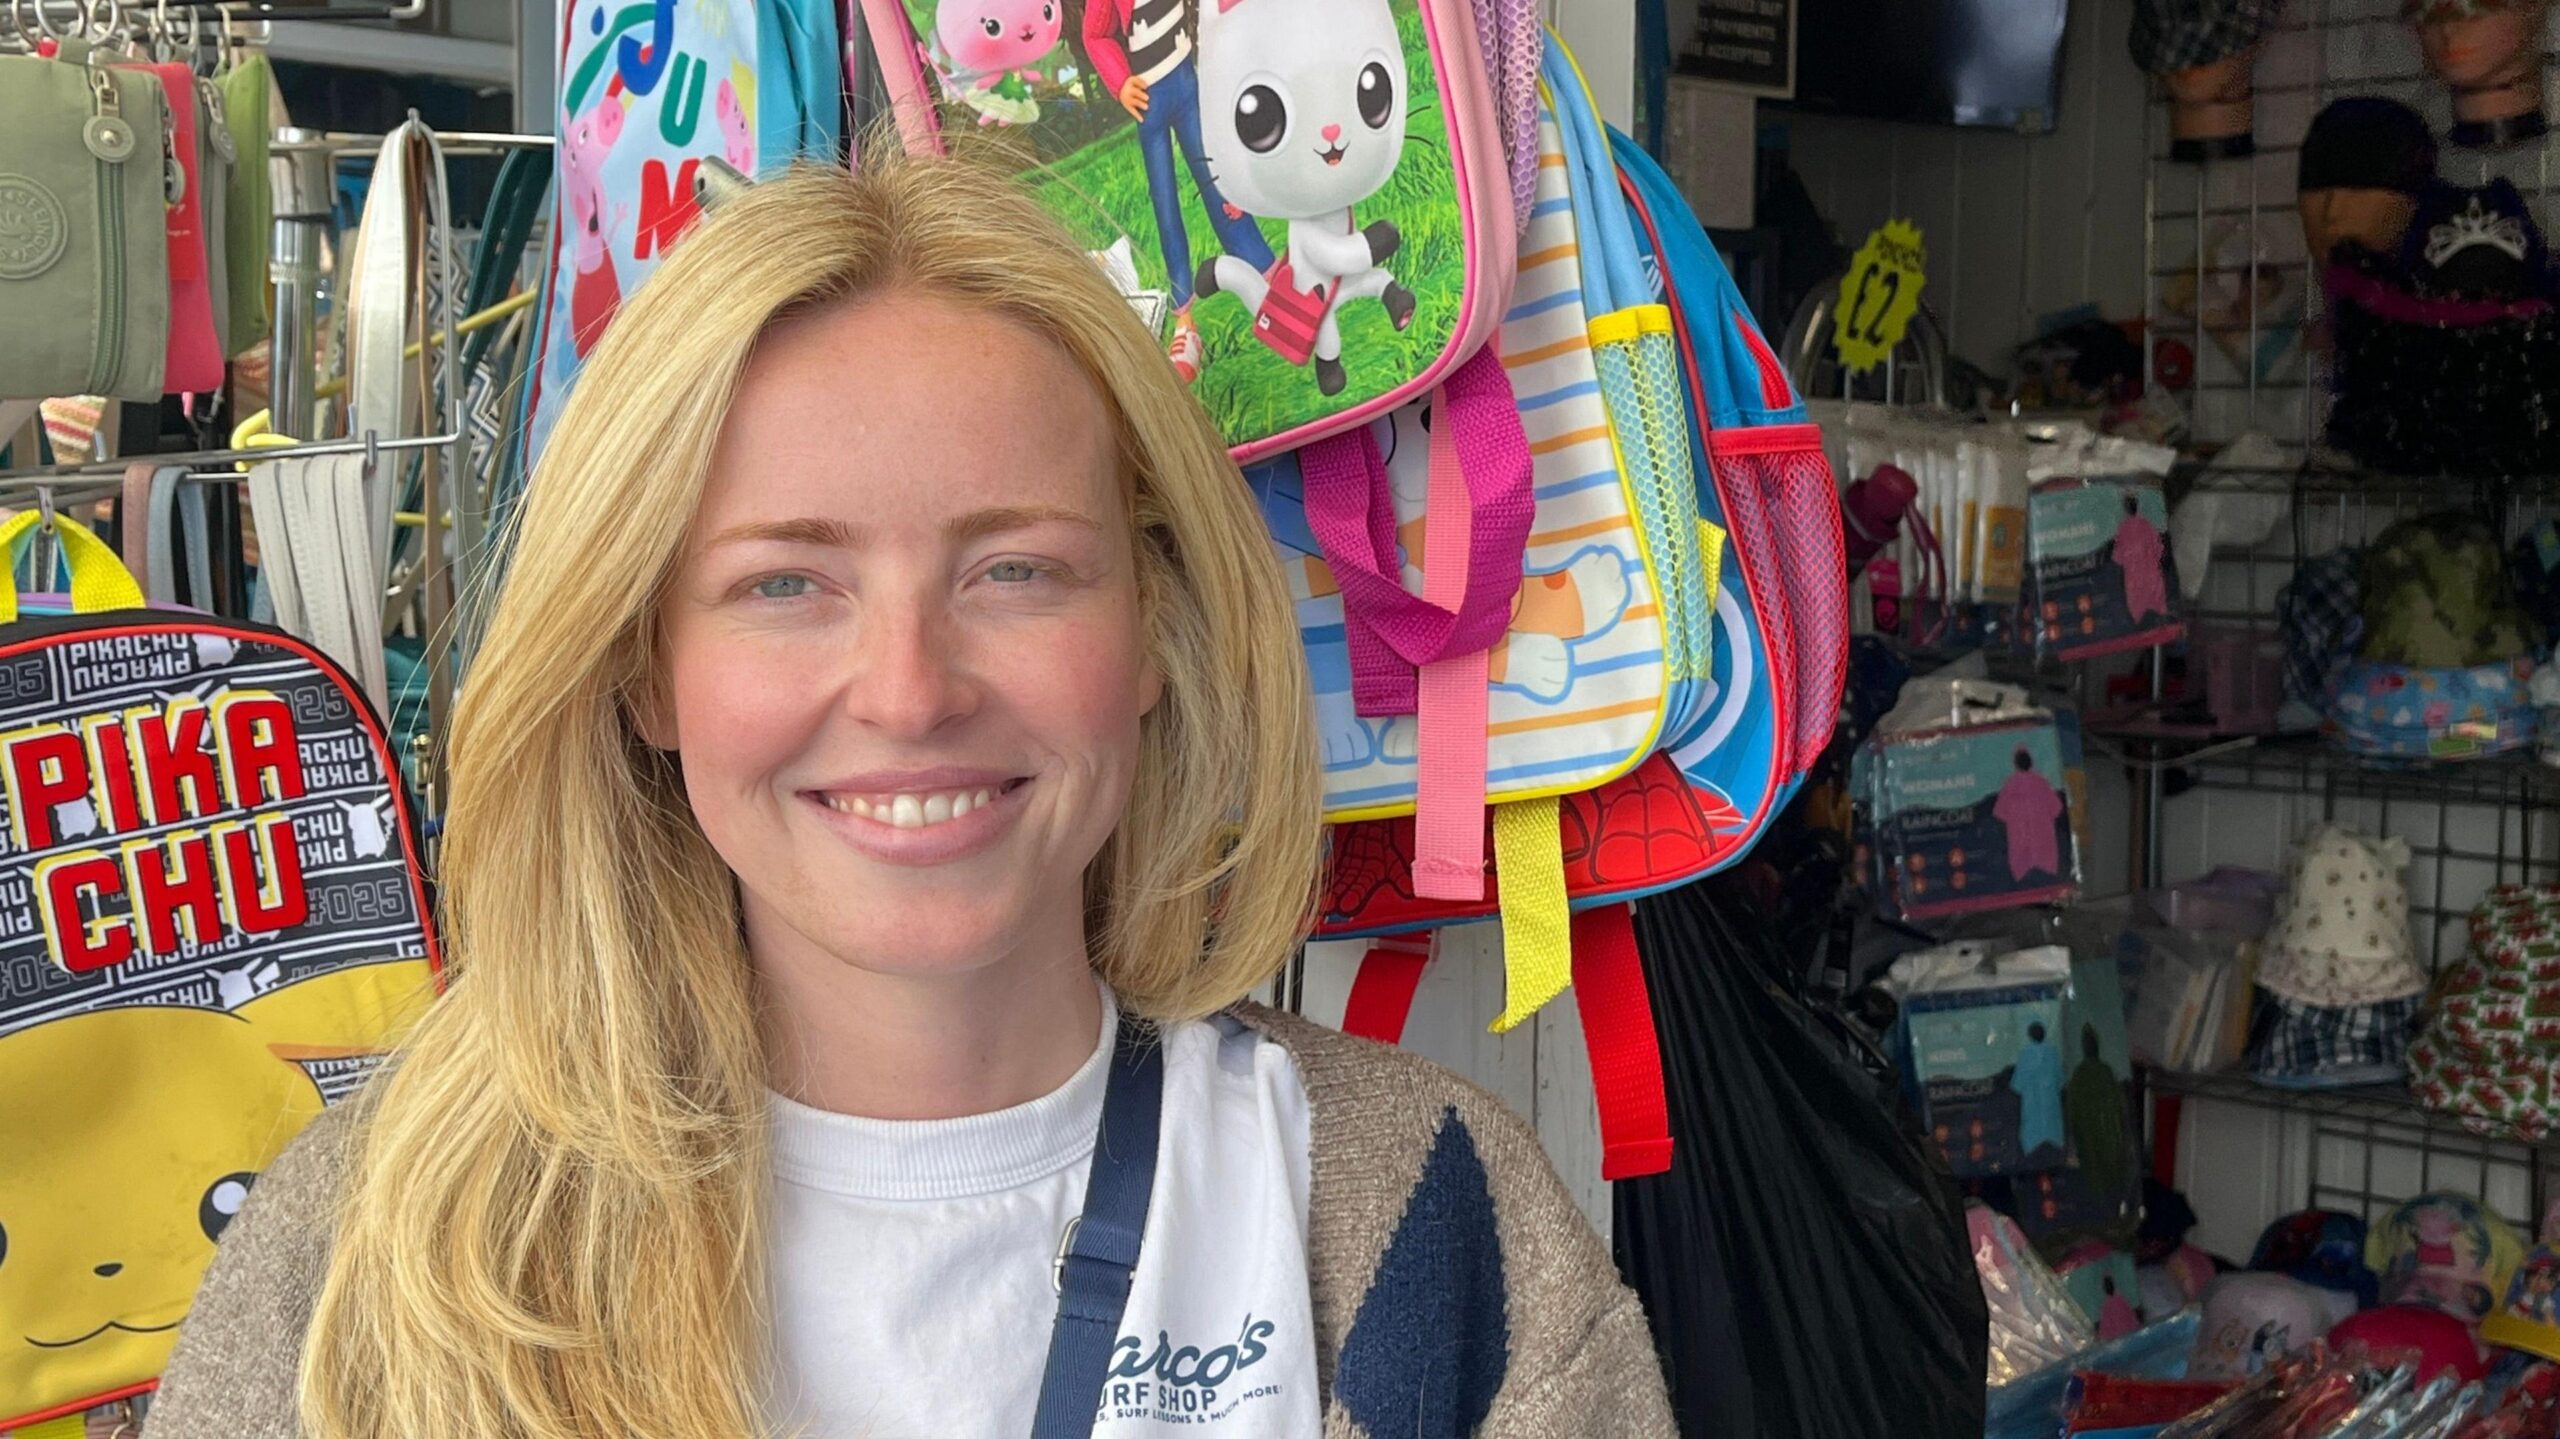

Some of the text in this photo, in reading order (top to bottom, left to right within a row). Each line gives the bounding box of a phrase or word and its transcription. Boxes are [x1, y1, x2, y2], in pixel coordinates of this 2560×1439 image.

[70, 633, 189, 665] PIKACHU
[3, 690, 306, 850] PIKA
[298, 736, 366, 768] ACHU
[34, 812, 308, 974] CHU
[304, 877, 406, 927] #025
[1104, 1312, 1275, 1387] arco's
[1098, 1382, 1217, 1413] RF SHOP
[1116, 1408, 1150, 1419] SURF
[1152, 1408, 1192, 1424] LESSONS
[1197, 1413, 1206, 1423] &
[1210, 1398, 1240, 1422] MUCH
